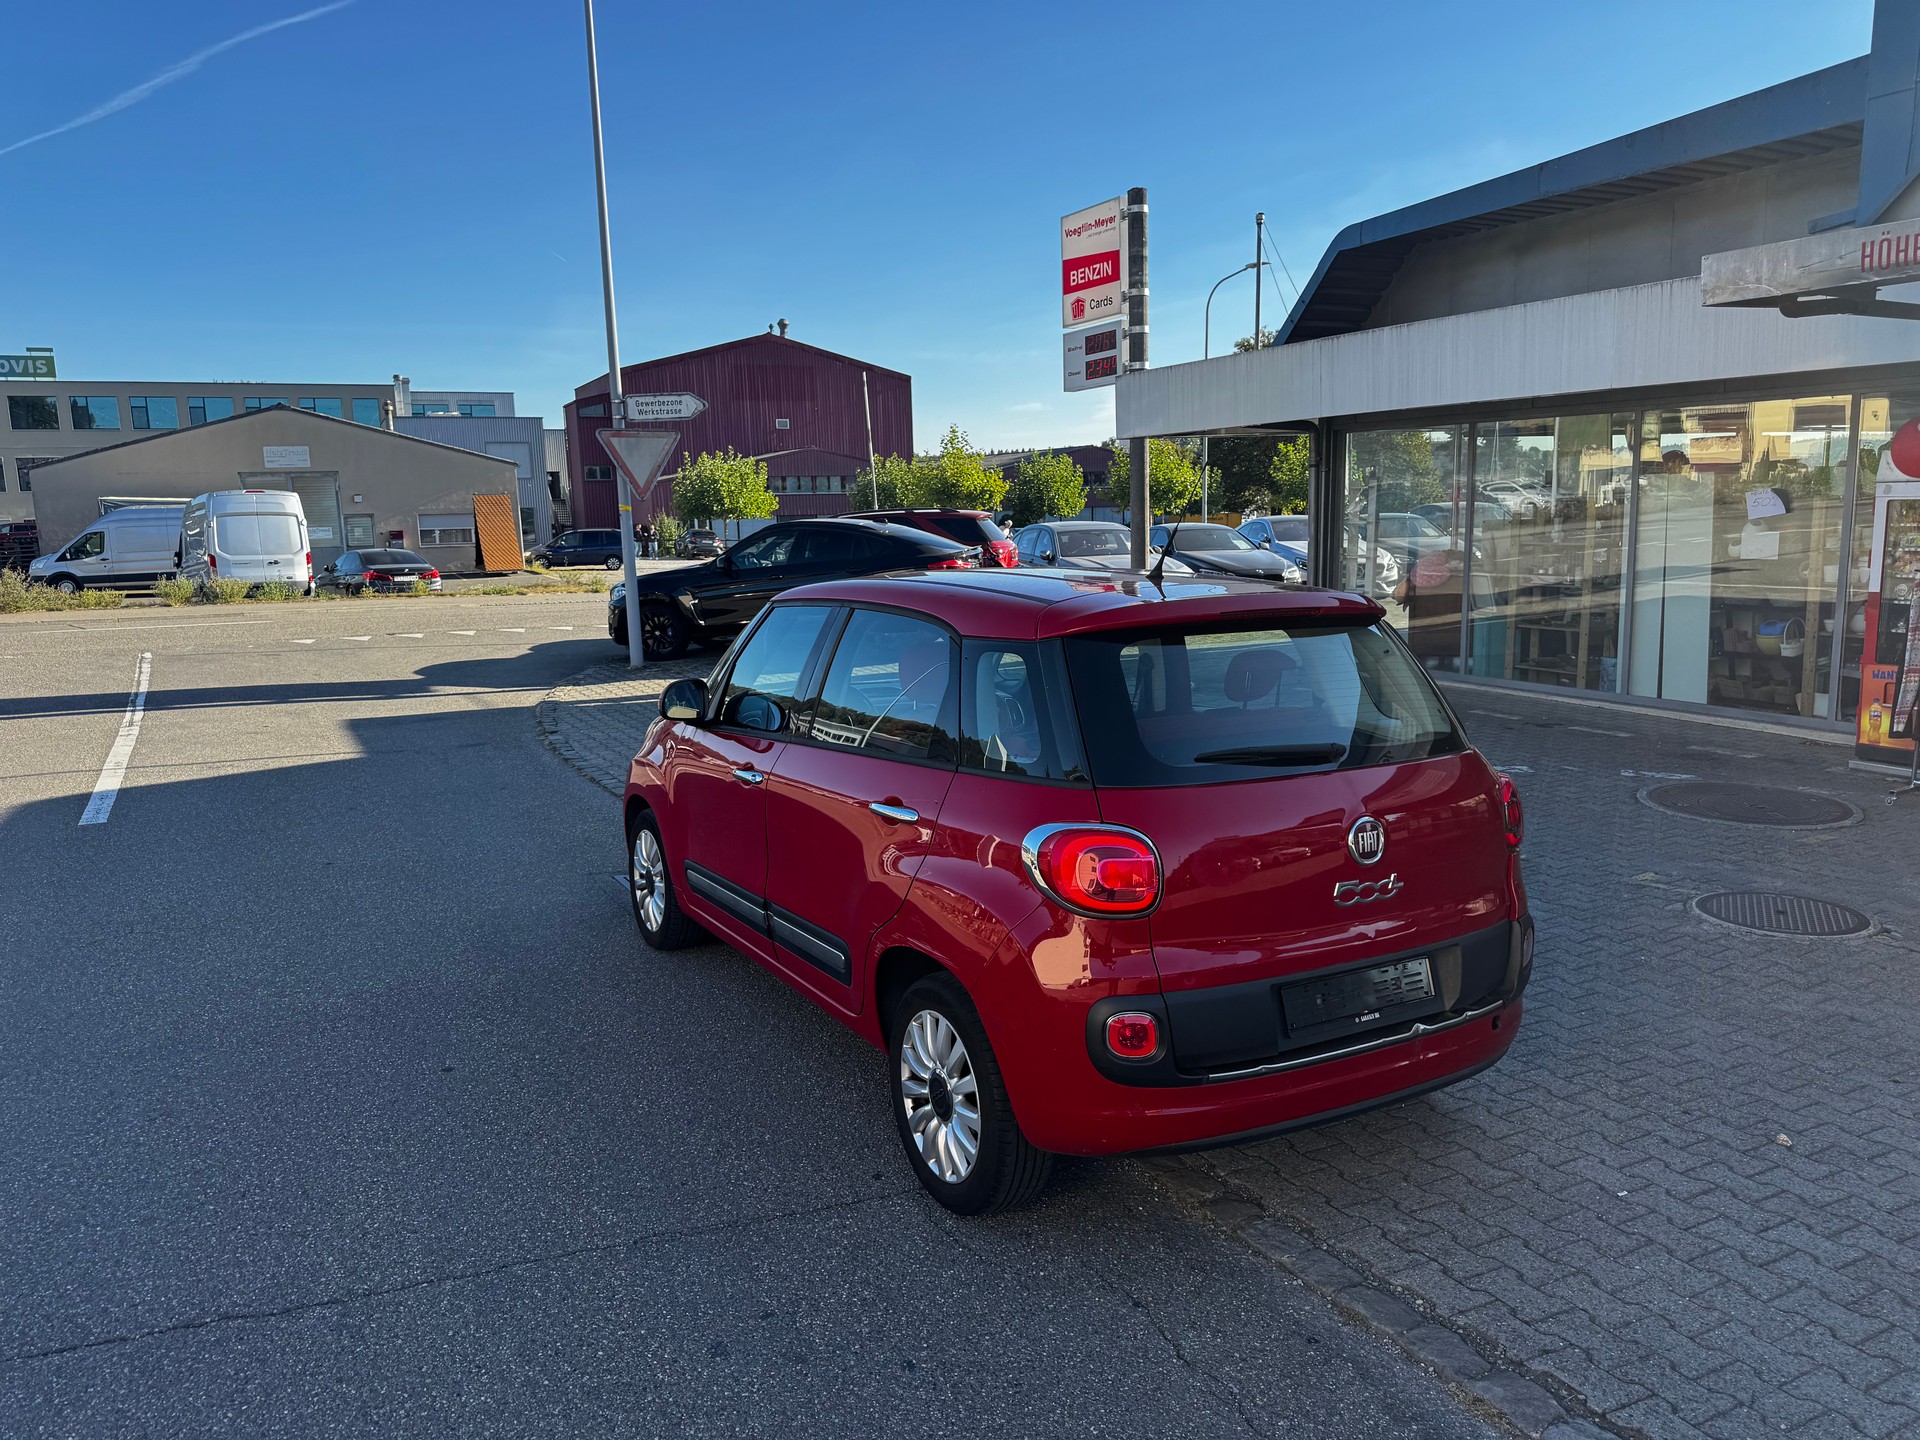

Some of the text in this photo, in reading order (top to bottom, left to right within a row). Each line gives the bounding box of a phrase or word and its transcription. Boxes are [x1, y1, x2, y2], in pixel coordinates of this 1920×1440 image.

[1065, 215, 1117, 238] Voegtlin-Meyer
[1070, 260, 1112, 286] BENZIN
[1089, 295, 1114, 310] Cards
[635, 399, 683, 408] Gewerbezone
[637, 408, 683, 416] Werkstrasse
[1872, 669, 1897, 681] WAN
[1358, 830, 1378, 853] FIAT
